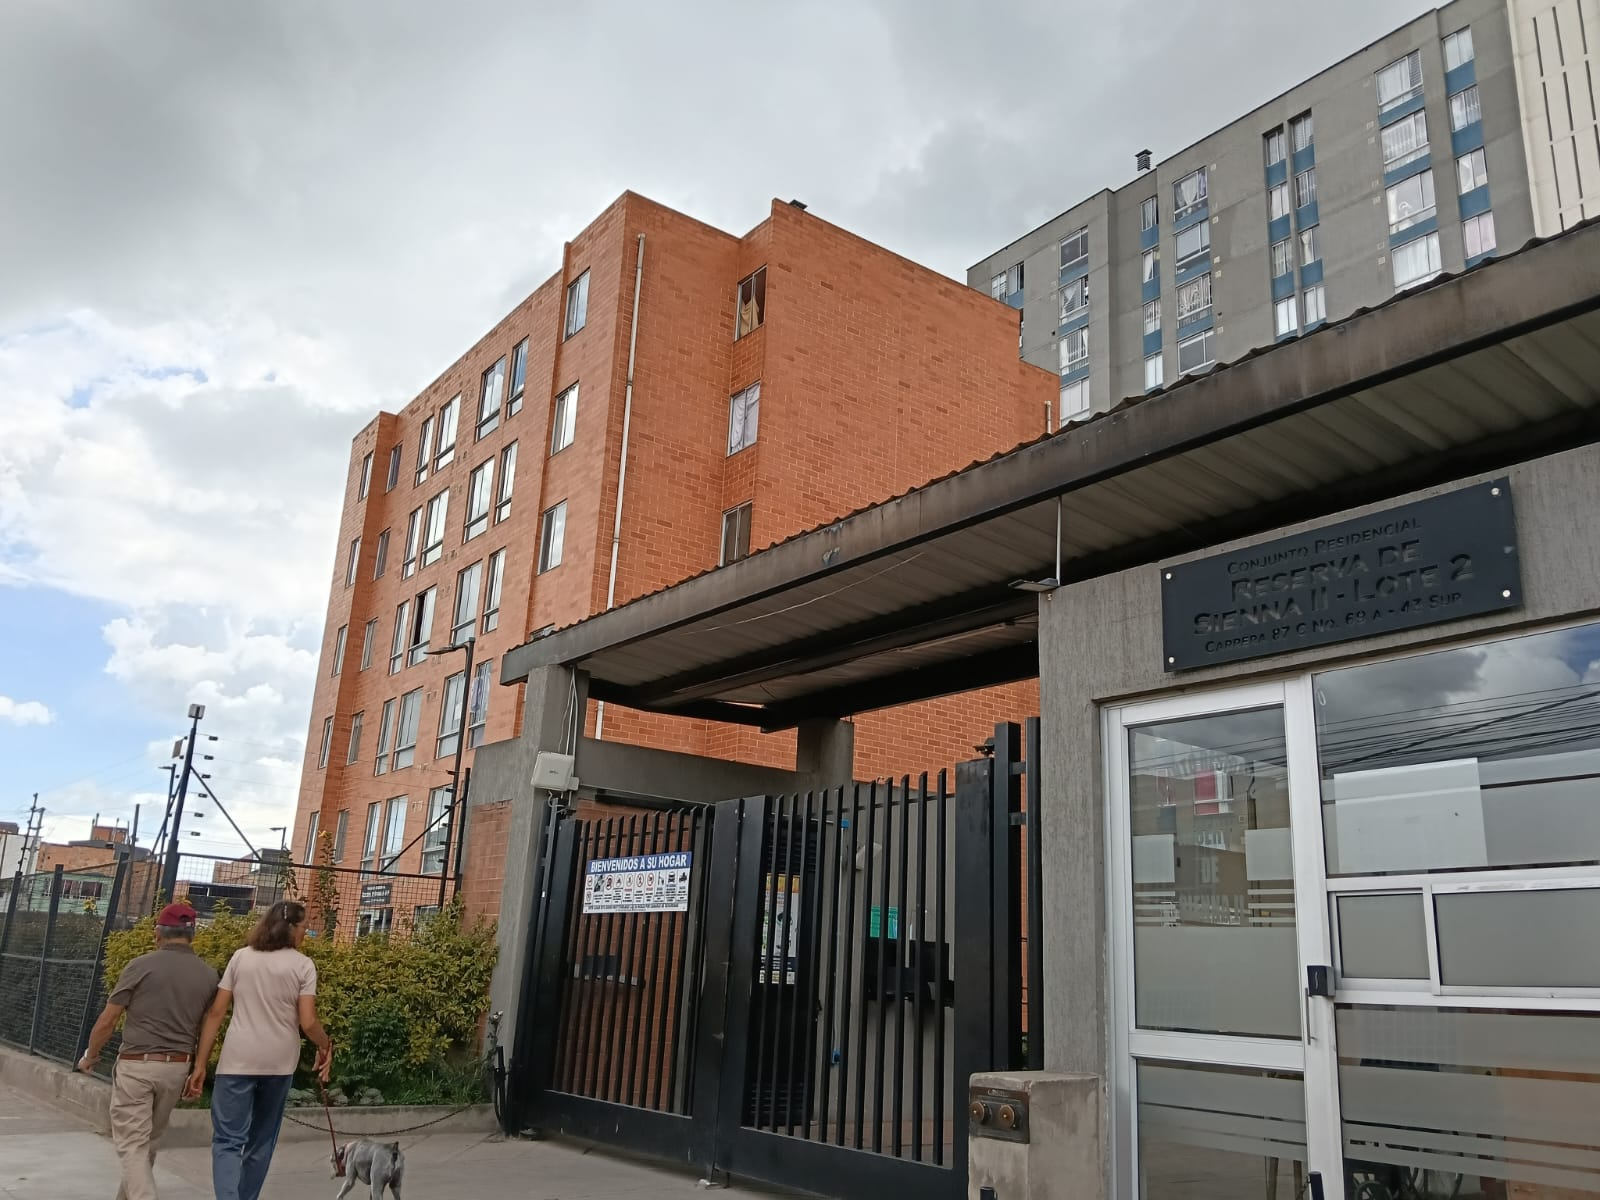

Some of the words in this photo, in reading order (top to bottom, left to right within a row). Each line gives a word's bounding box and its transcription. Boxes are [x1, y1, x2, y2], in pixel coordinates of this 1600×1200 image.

[1228, 547, 1308, 574] CONJUNTO
[1315, 520, 1421, 554] RESIDENCIAL
[1231, 554, 1370, 602] RESERVA
[1378, 539, 1422, 566] DE
[1193, 596, 1303, 636] SIENNA
[1354, 564, 1440, 602] LOTE
[1449, 553, 1474, 581] 2
[1205, 633, 1265, 653] CARRERA
[1272, 625, 1290, 640] 87
[1296, 623, 1307, 637] C
[1372, 609, 1384, 620] A
[591, 858, 638, 872] BIENVENIDOS
[640, 858, 645, 869] A
[647, 856, 658, 869] SU
[659, 855, 687, 867] HOGAR
